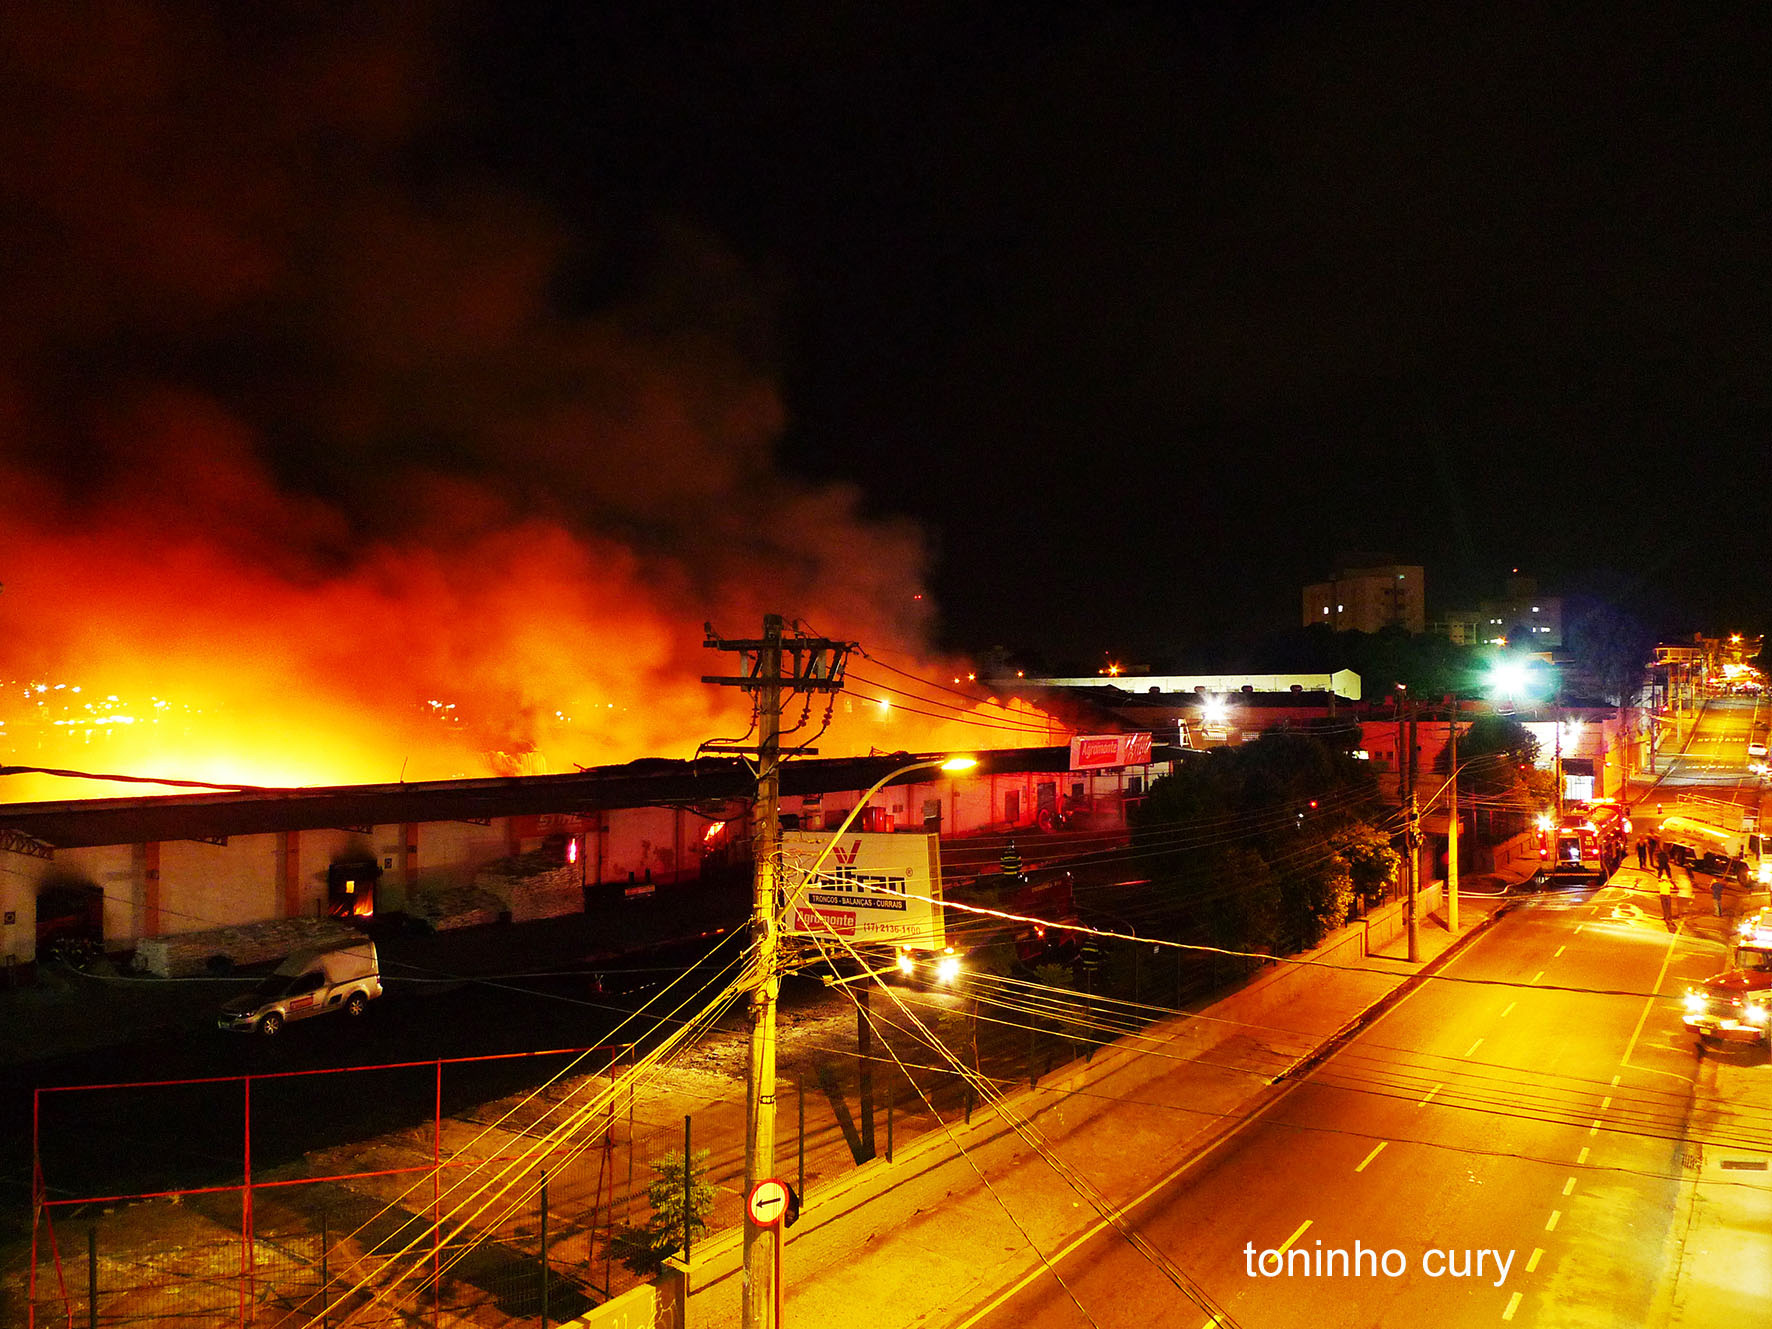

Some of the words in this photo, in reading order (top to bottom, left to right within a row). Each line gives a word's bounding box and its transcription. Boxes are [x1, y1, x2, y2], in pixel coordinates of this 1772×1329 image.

[812, 895, 838, 904] TRONCOS
[842, 897, 873, 907] BALANÇAS
[876, 900, 903, 909] CURRAIS
